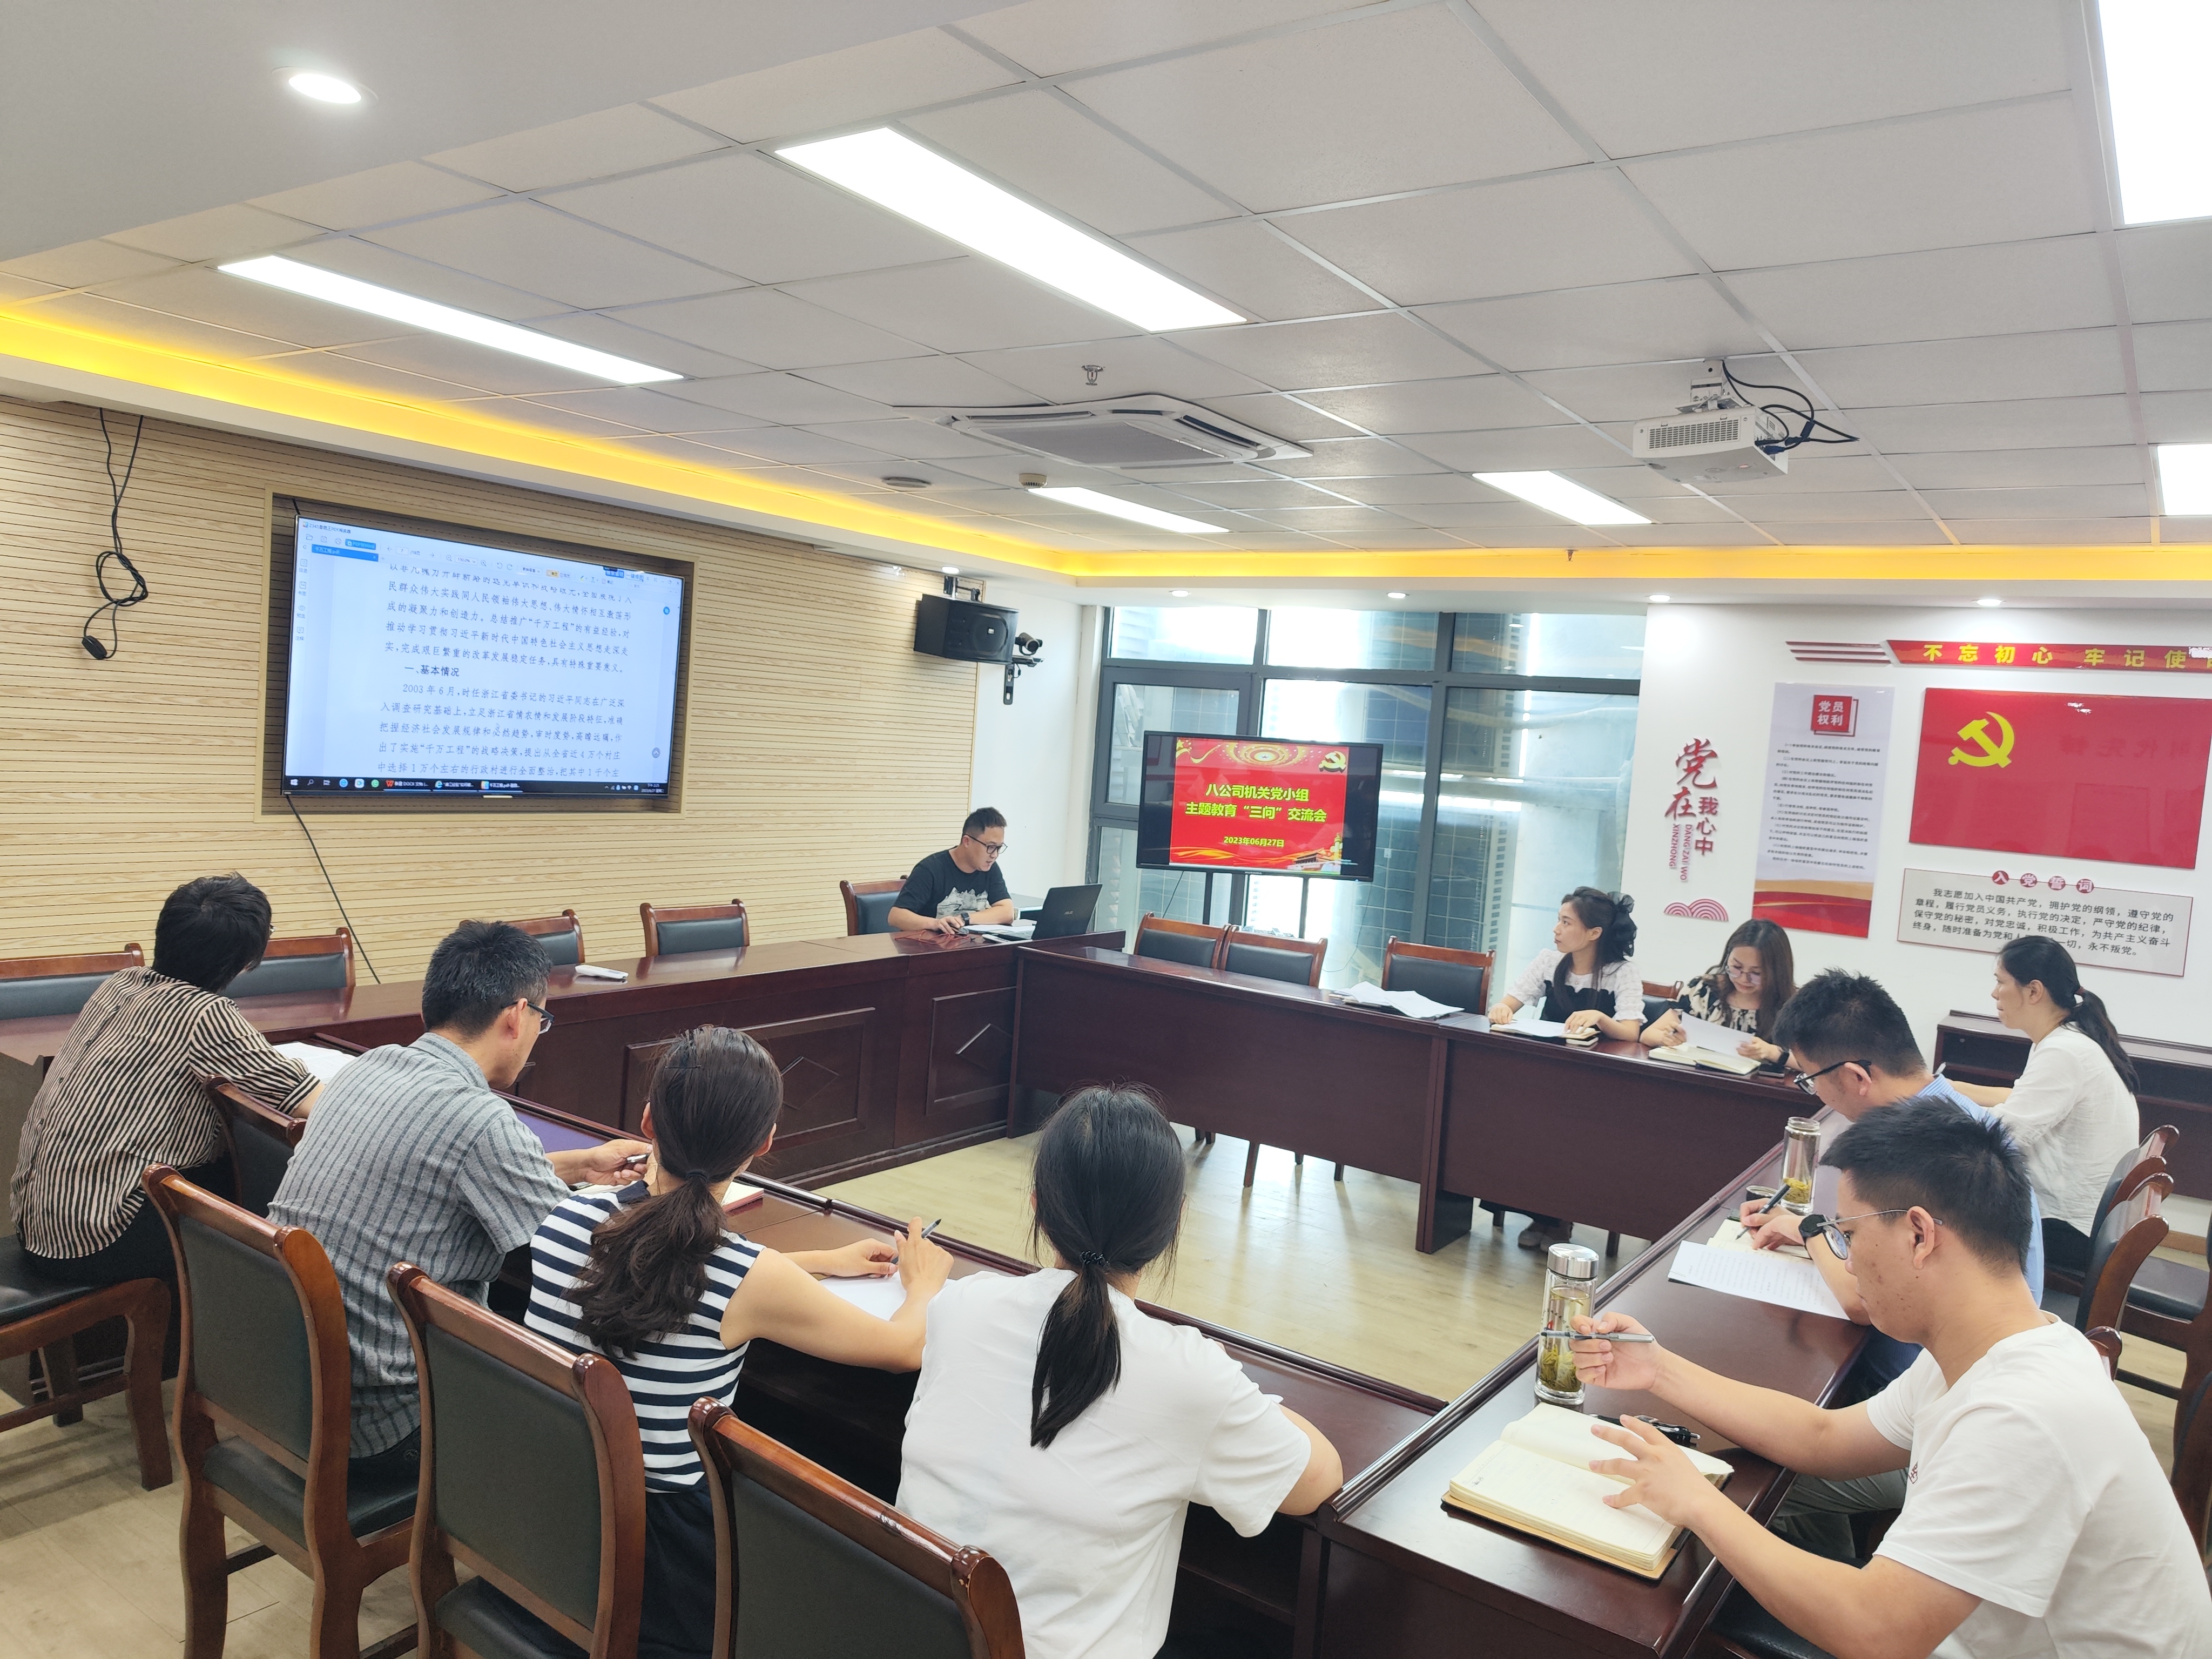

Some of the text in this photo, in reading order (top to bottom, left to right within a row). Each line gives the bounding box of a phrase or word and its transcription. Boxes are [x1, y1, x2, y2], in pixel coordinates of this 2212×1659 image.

[1923, 644, 2212, 669] 不忘初心 牢记使
[404, 664, 460, 677] 一、基本情况
[1818, 700, 1844, 713] 党员
[1817, 713, 1843, 726] 权利
[1205, 783, 1310, 802] 八公司机关党小组
[1223, 836, 1285, 848] 2023年06月27日
[1669, 824, 1680, 868] XINZHONG
[1683, 824, 1692, 848] DANG
[1680, 866, 1688, 881] WO
[1994, 872, 2094, 893] 入党誓词
[1933, 888, 2174, 922] 我志愿加入中国共产党，拥护党的纲领，遵守党的
[1914, 909, 2170, 947] 保守党的秘密，对党忠诚，积极工作，为共产主义奋斗
